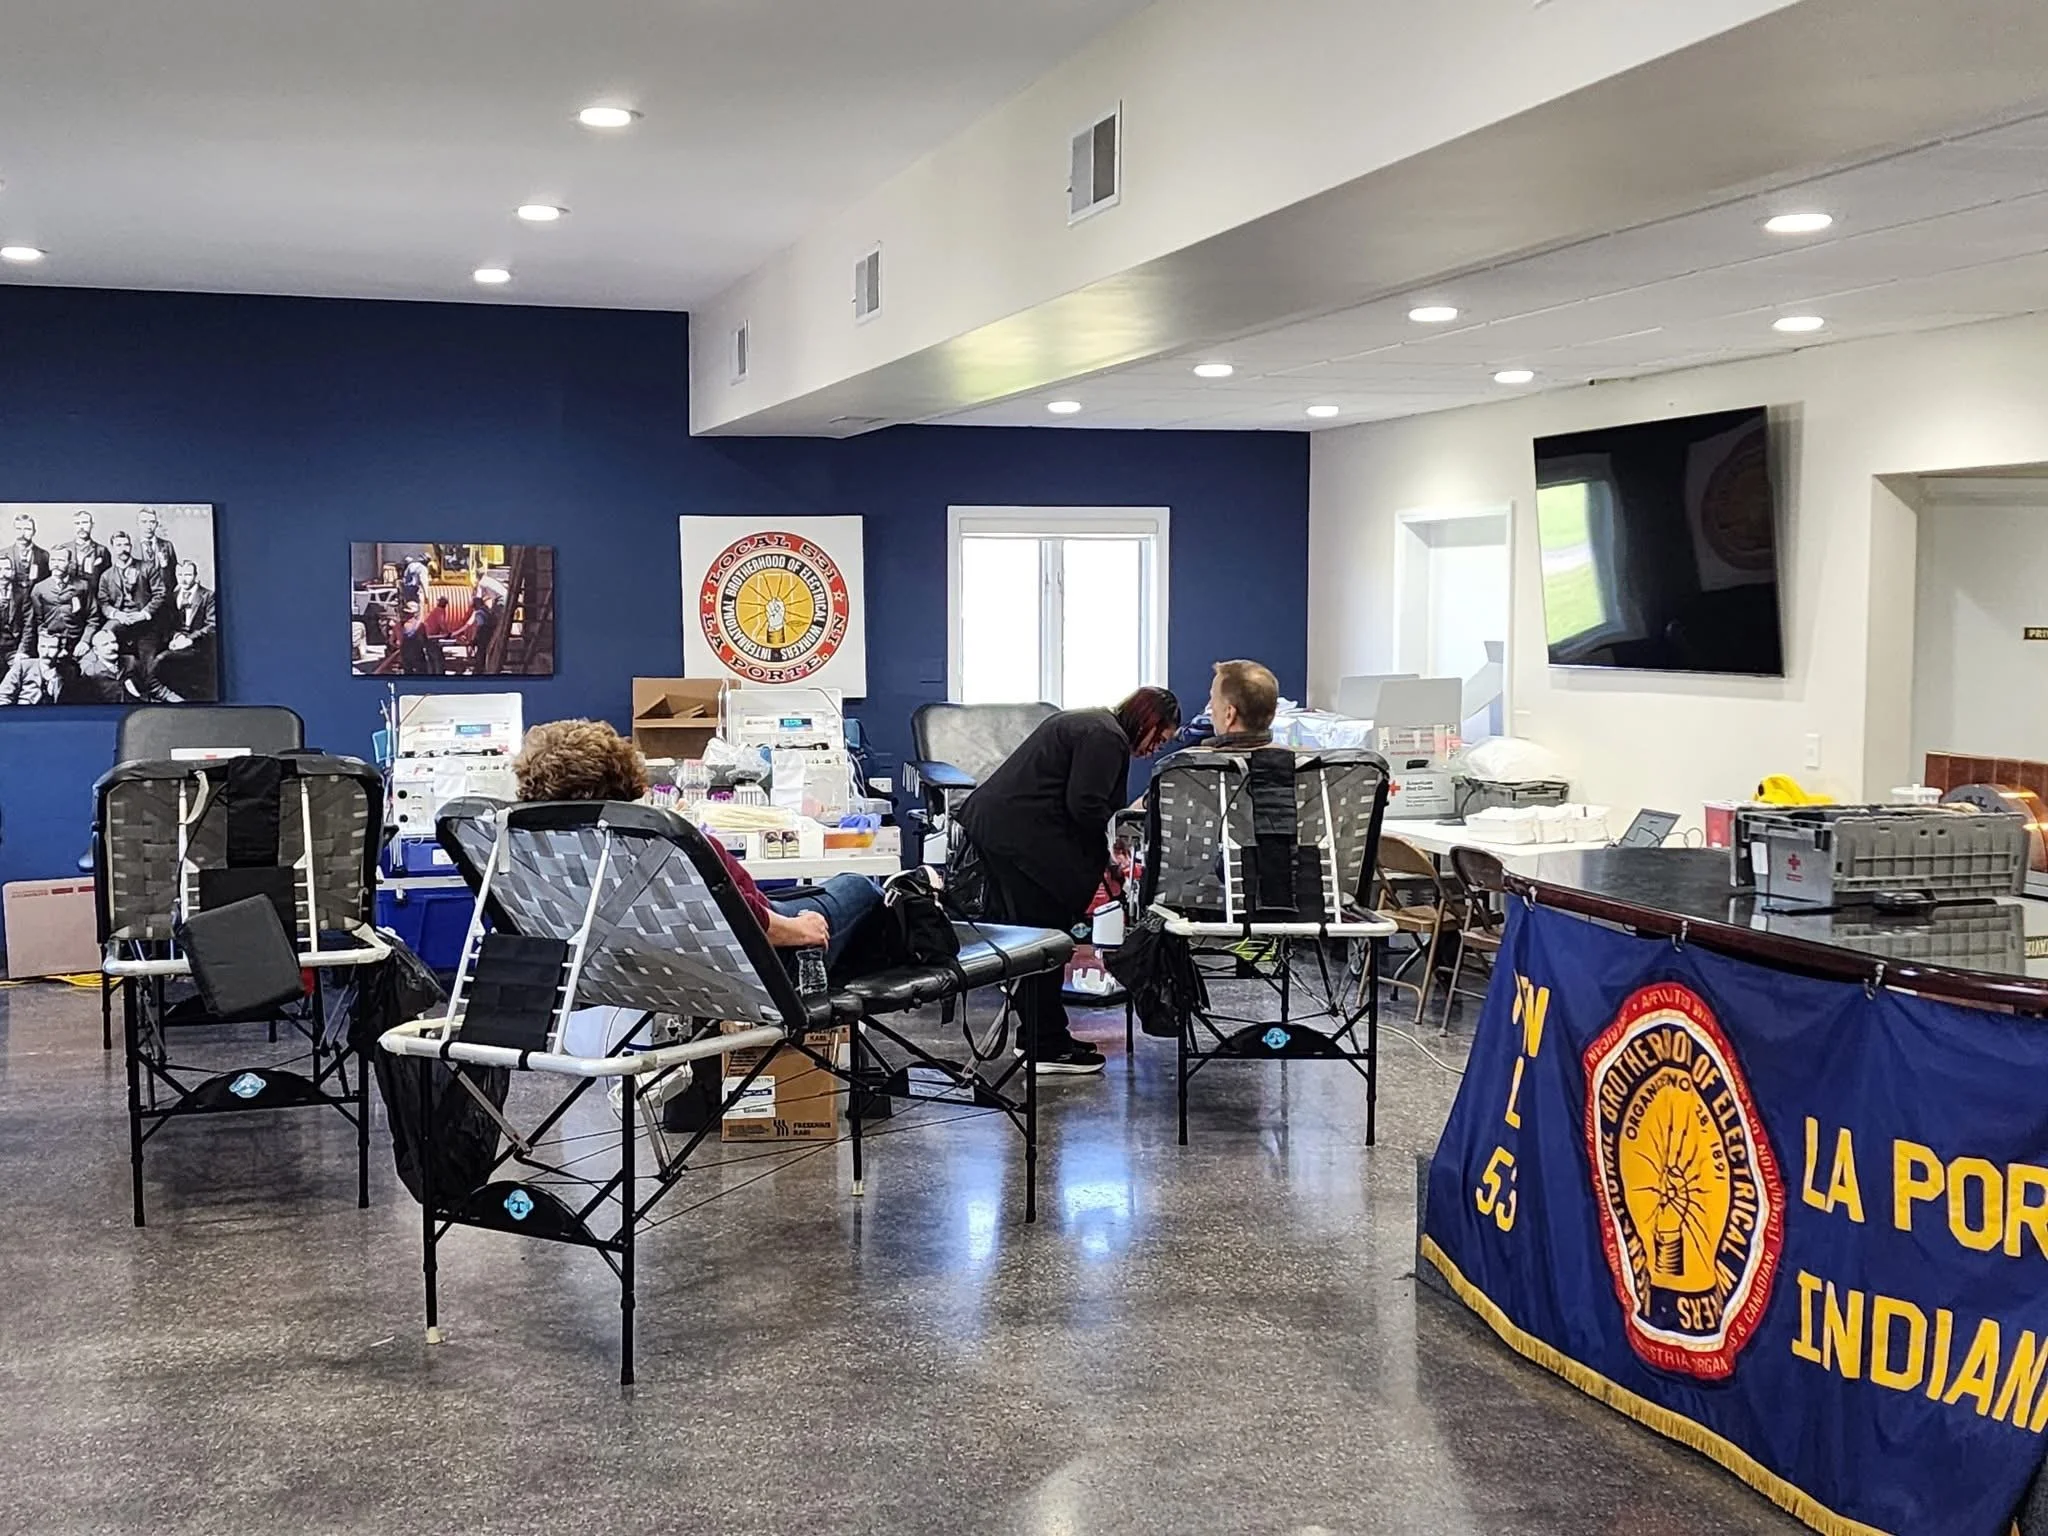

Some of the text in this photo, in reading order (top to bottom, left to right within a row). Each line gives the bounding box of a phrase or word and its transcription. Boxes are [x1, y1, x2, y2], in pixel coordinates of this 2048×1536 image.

[709, 536, 835, 586] LOCAL 531
[704, 614, 726, 652] LA
[828, 615, 846, 648] IN
[722, 556, 827, 661] INTERNATIONAL BROTHERHOOD OF ELECTRICAL WORKERS
[1692, 1054, 1720, 1090] OF
[1712, 1090, 1757, 1261] ELECTRICAL
[1710, 1142, 1726, 1180] 1891
[1802, 1116, 2048, 1261] LA POR
[1744, 1252, 1775, 1325] CANADIAN
